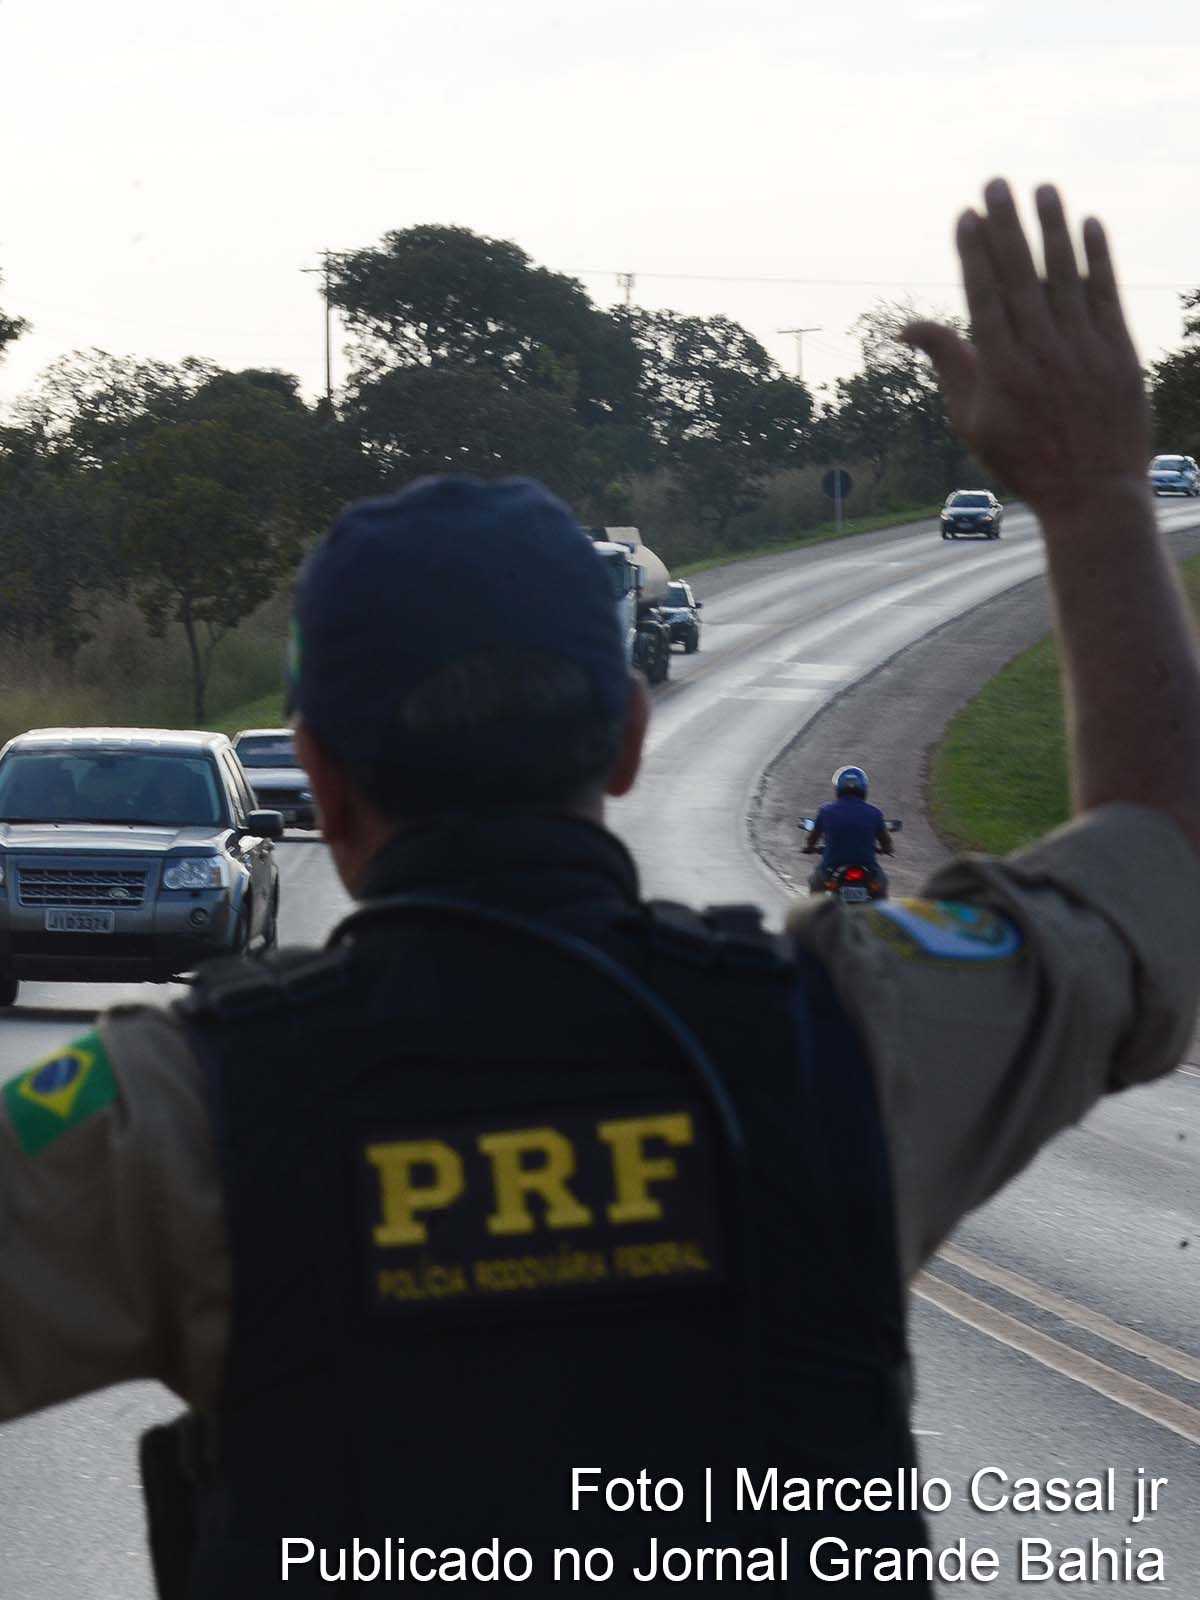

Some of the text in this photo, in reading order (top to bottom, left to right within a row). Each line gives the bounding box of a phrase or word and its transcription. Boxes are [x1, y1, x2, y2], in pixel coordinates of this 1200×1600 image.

[365, 1111, 695, 1248] PRF
[375, 1254, 470, 1301] POLÍCIA
[613, 1241, 710, 1280] FEDERAL
